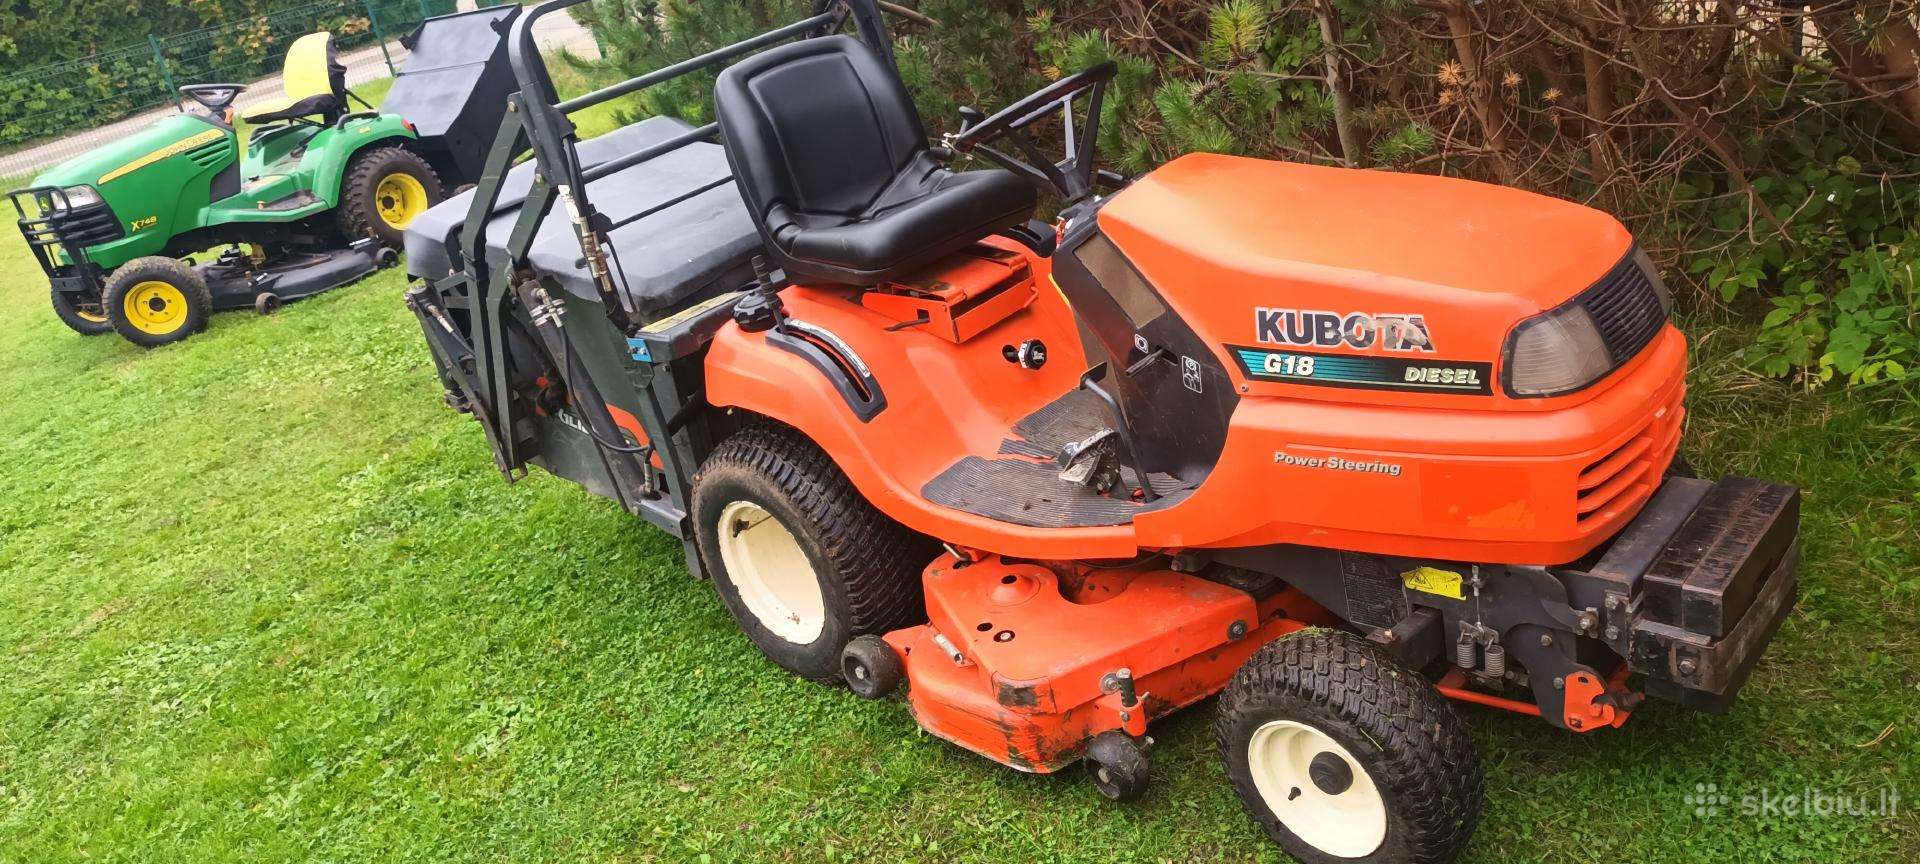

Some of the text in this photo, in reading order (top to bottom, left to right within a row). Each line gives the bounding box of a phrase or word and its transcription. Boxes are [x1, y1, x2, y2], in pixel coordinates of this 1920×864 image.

[131, 215, 157, 231] X748
[1256, 308, 1436, 352] KUBOTA
[1263, 353, 1315, 376] G18
[1404, 366, 1480, 385] DIESEL
[1273, 451, 1402, 476] Power Steering
